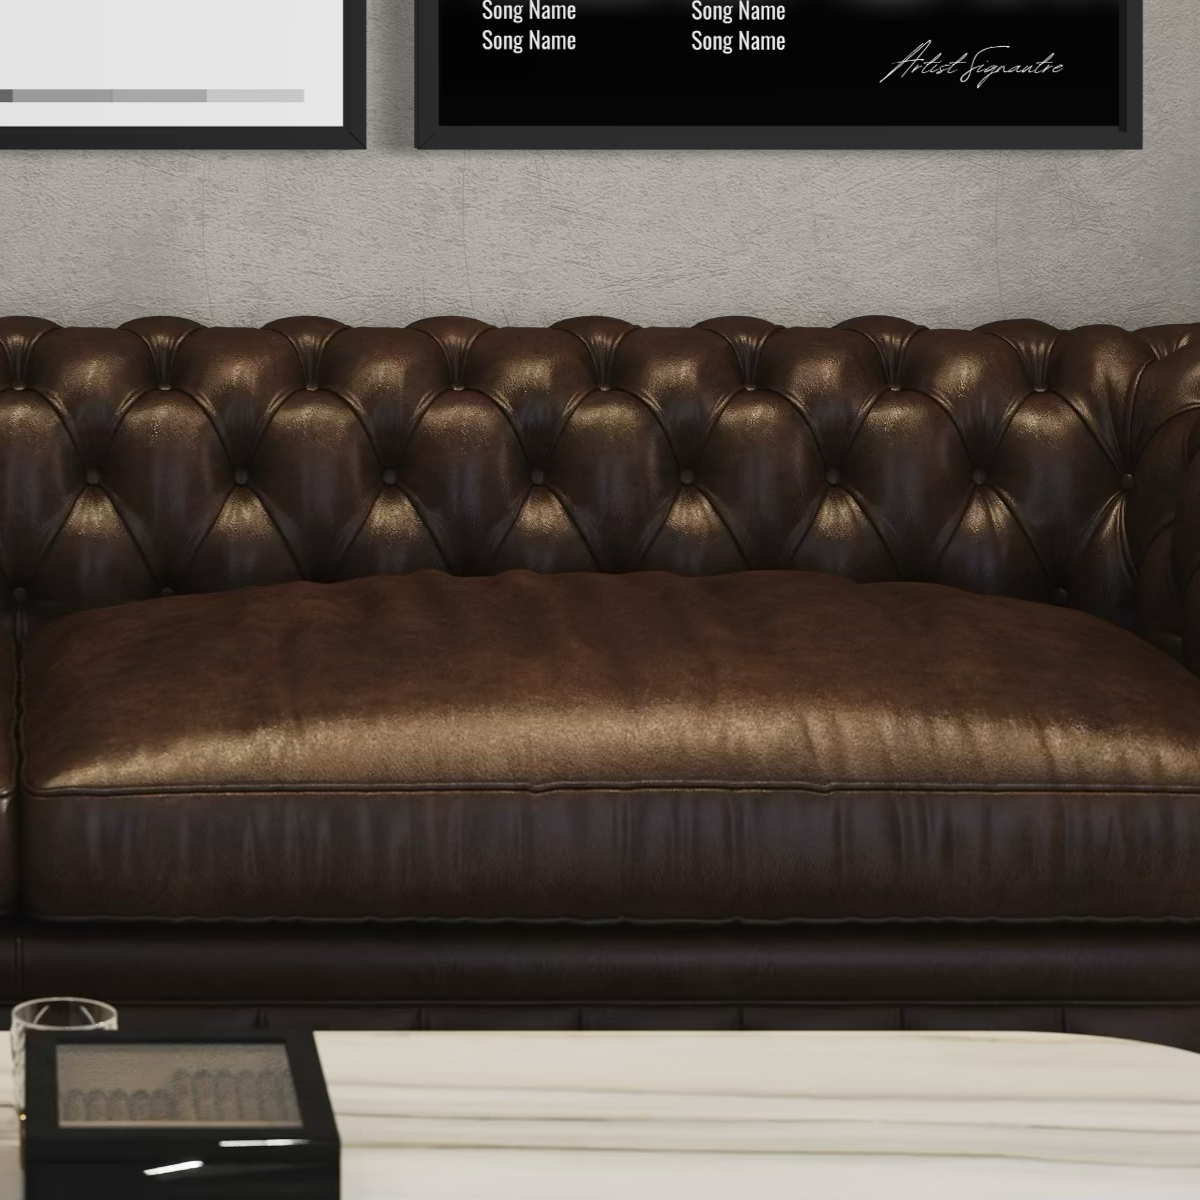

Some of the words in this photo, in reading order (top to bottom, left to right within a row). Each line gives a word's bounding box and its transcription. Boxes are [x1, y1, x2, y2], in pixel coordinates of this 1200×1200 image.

[482, 0, 523, 23] Song
[530, 0, 576, 19] Name
[692, 0, 733, 24] Song
[739, 0, 785, 20] Name
[482, 29, 524, 54] Song
[530, 30, 576, 50] Name
[692, 30, 733, 54] Song
[739, 30, 785, 50] Name
[879, 39, 969, 83] Artist
